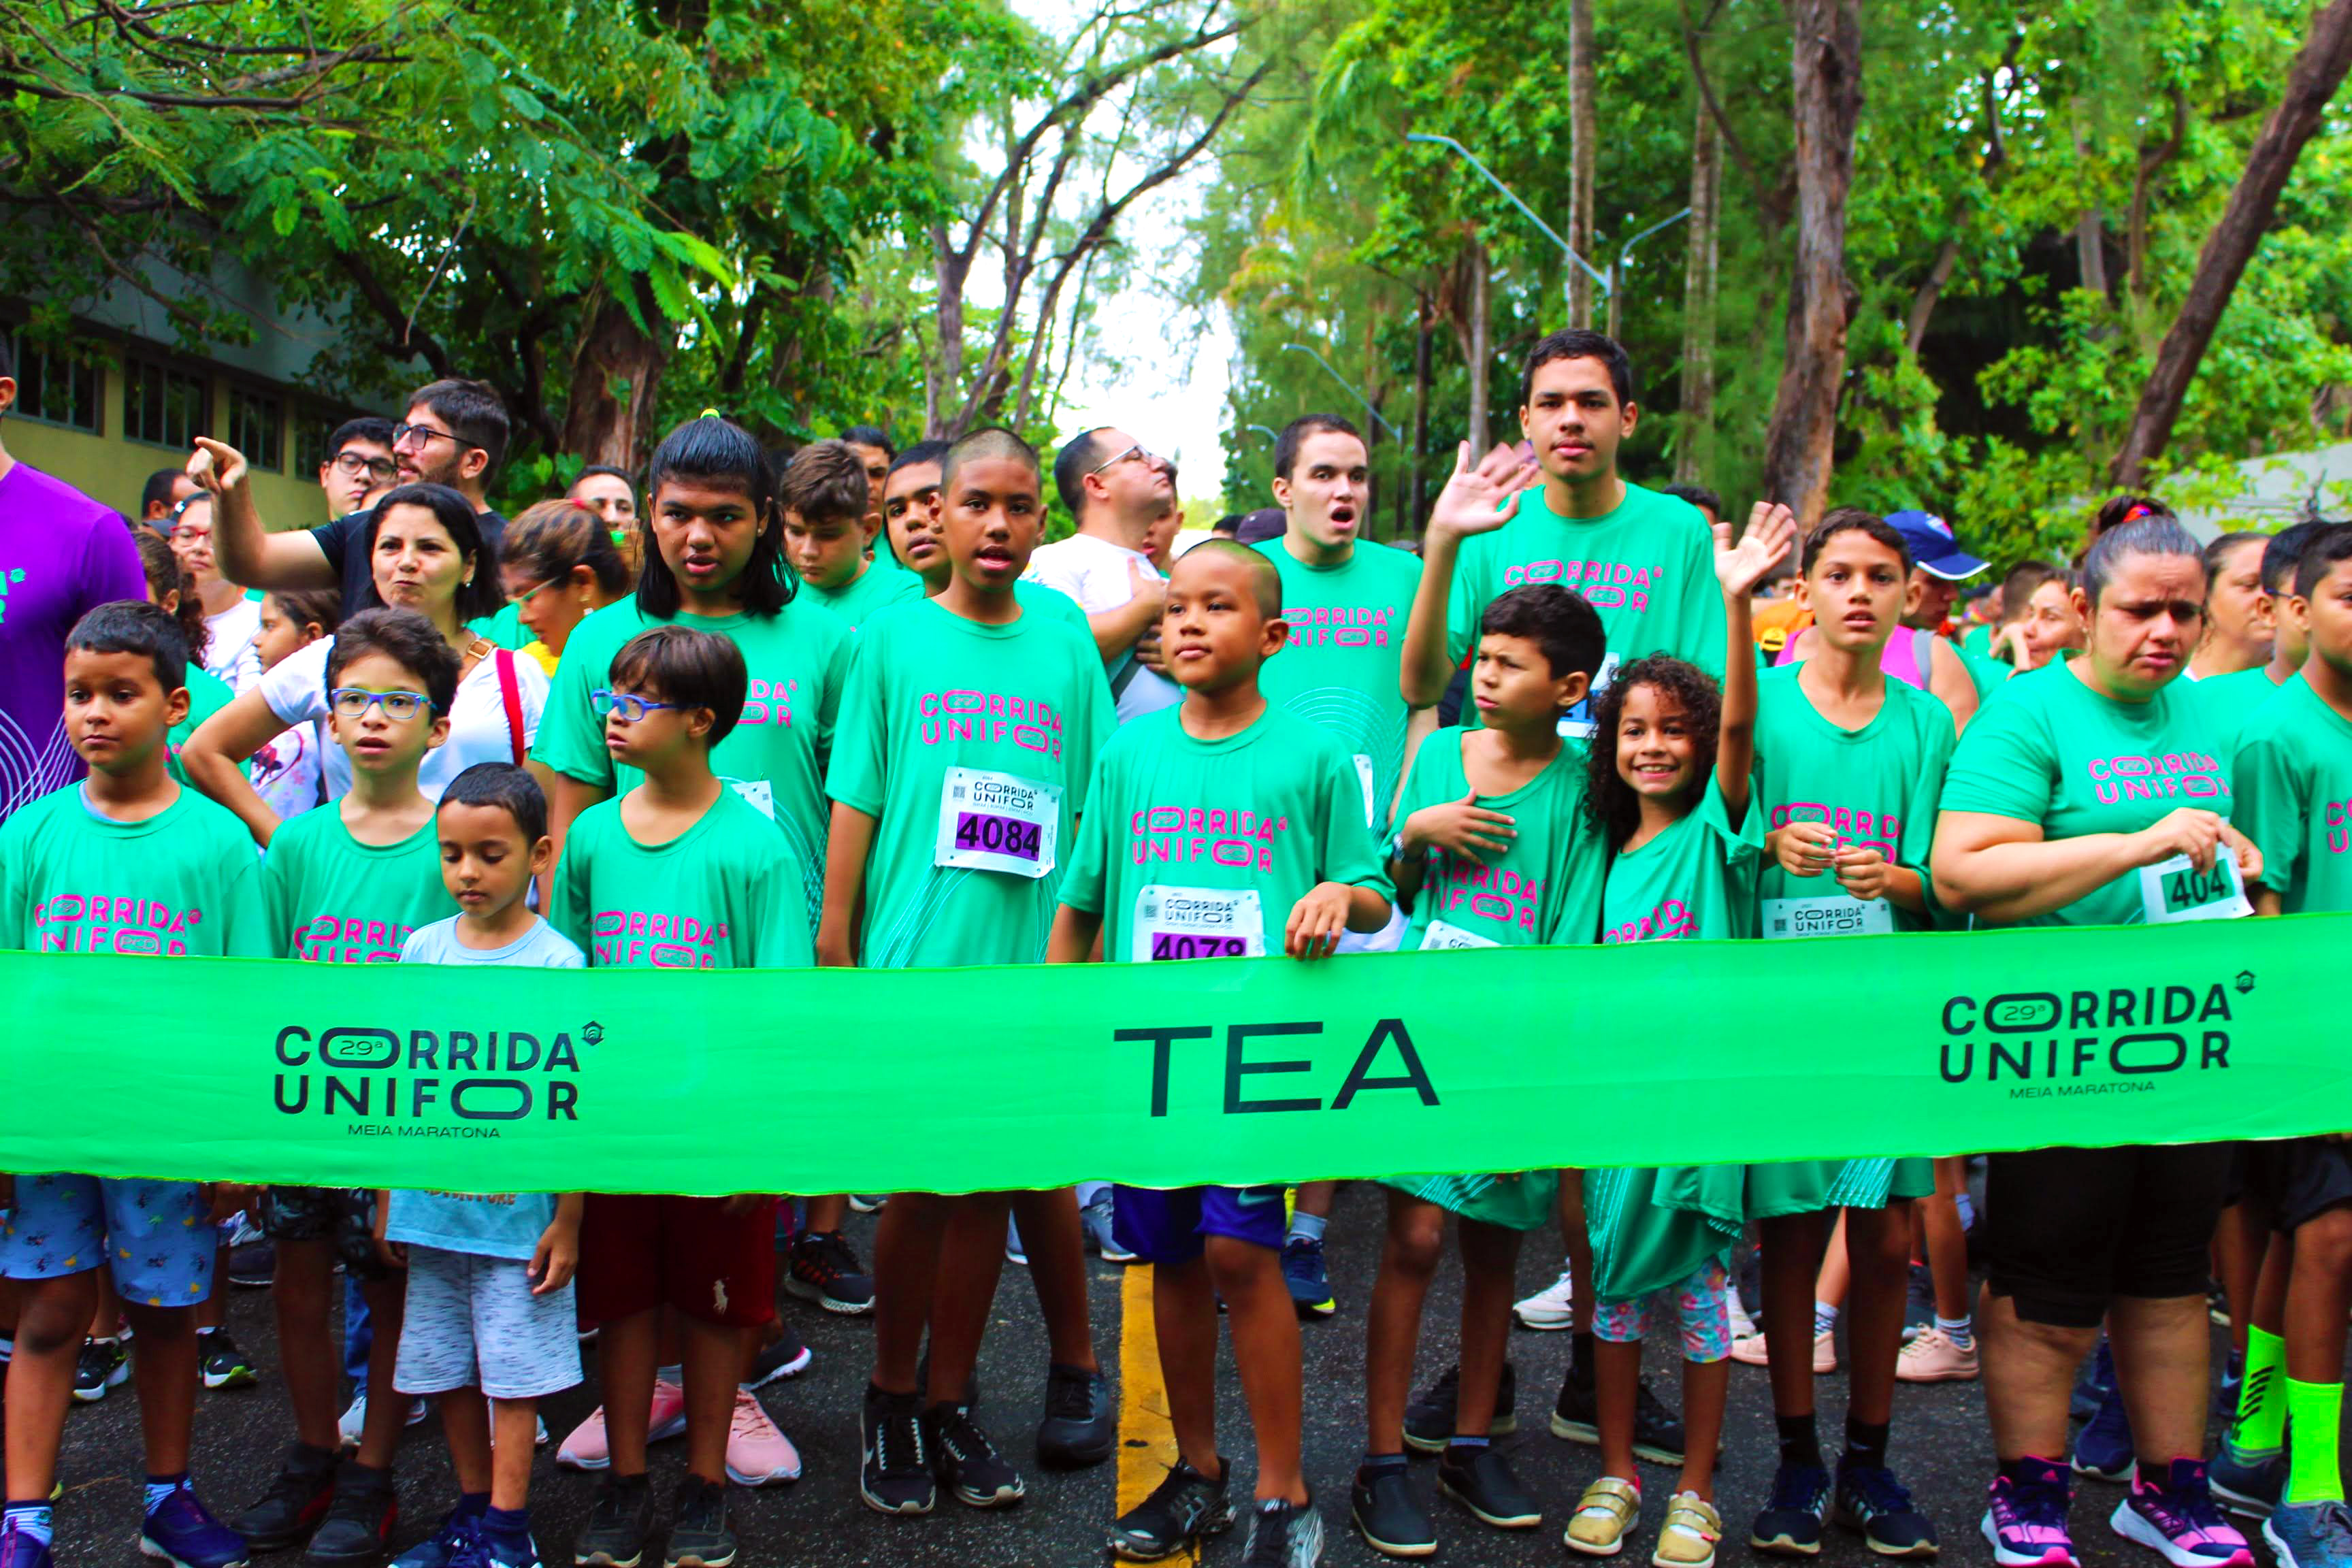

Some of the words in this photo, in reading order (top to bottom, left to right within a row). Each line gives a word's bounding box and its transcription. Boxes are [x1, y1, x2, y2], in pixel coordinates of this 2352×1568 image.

[1504, 559, 1650, 589] CORRIDA
[1282, 607, 1388, 626] ORRIDA
[1286, 627, 1389, 647] NIFOR
[919, 689, 1062, 736] CORRIDA
[921, 717, 1062, 763] UNIFOR
[974, 792, 1033, 811] UNIFOR
[975, 781, 1034, 800] CORRIDA
[956, 815, 1040, 858] 4084
[1131, 806, 1275, 845] CORRIDA
[1132, 837, 1273, 875] UNIFOR
[2171, 864, 2226, 906] 404
[34, 894, 185, 936] CORRIDA
[591, 910, 714, 949] ORRIDA
[1795, 907, 1862, 921] CORRIDA
[1795, 918, 1863, 932] UNIFOR
[594, 938, 715, 968] NIFOR
[1942, 984, 2232, 1035] CORRIDA
[276, 1026, 581, 1073] CORRIDA
[1114, 1018, 1441, 1117] TEA
[1940, 1031, 2230, 1083] UNIFOR
[274, 1074, 578, 1120] UNIFOR
[2010, 1087, 2053, 1099] MEIA
[2058, 1081, 2155, 1097] MARATONA
[348, 1124, 393, 1136] MEIA
[397, 1126, 501, 1139] MARATONA
